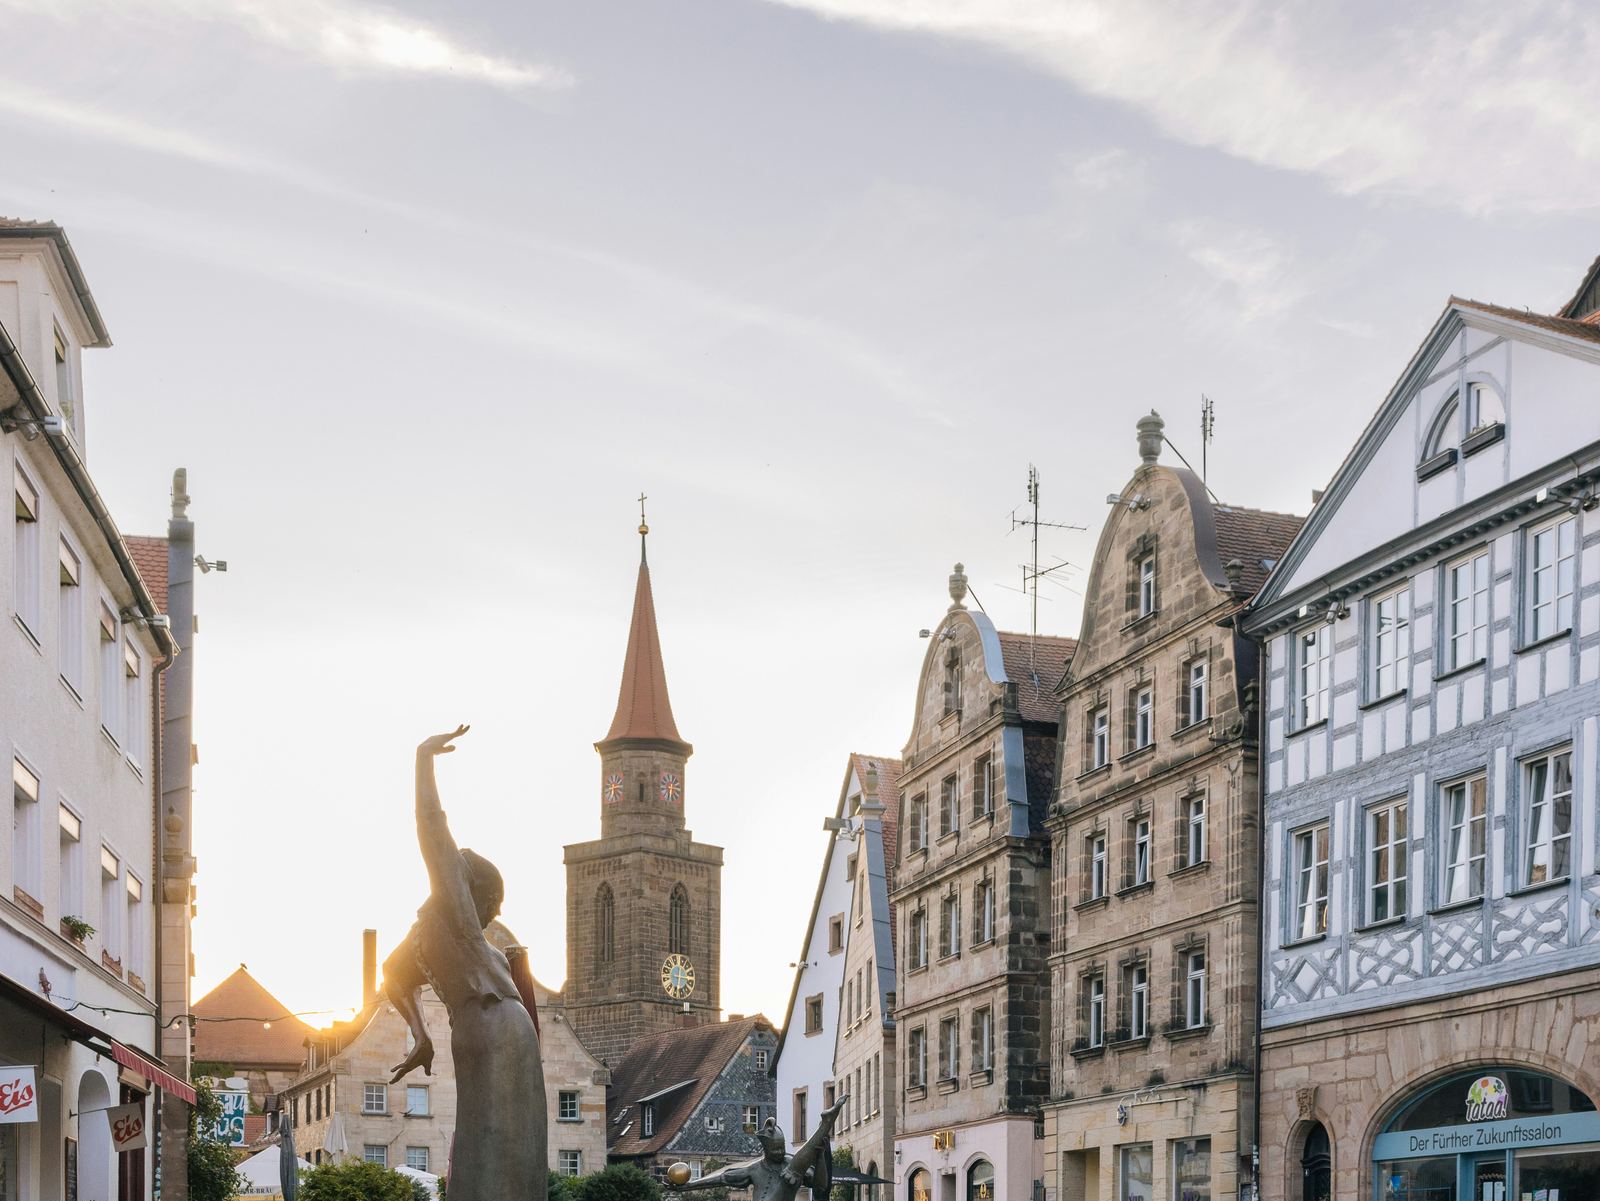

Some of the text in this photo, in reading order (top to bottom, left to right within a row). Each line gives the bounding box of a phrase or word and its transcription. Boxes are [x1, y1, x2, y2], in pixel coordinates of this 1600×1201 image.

[0, 1079, 33, 1112] Eis
[1466, 1094, 1508, 1121] Tataa!
[113, 1115, 142, 1143] Eis
[1410, 1122, 1561, 1152] Der Fürther Zukunftssalon
